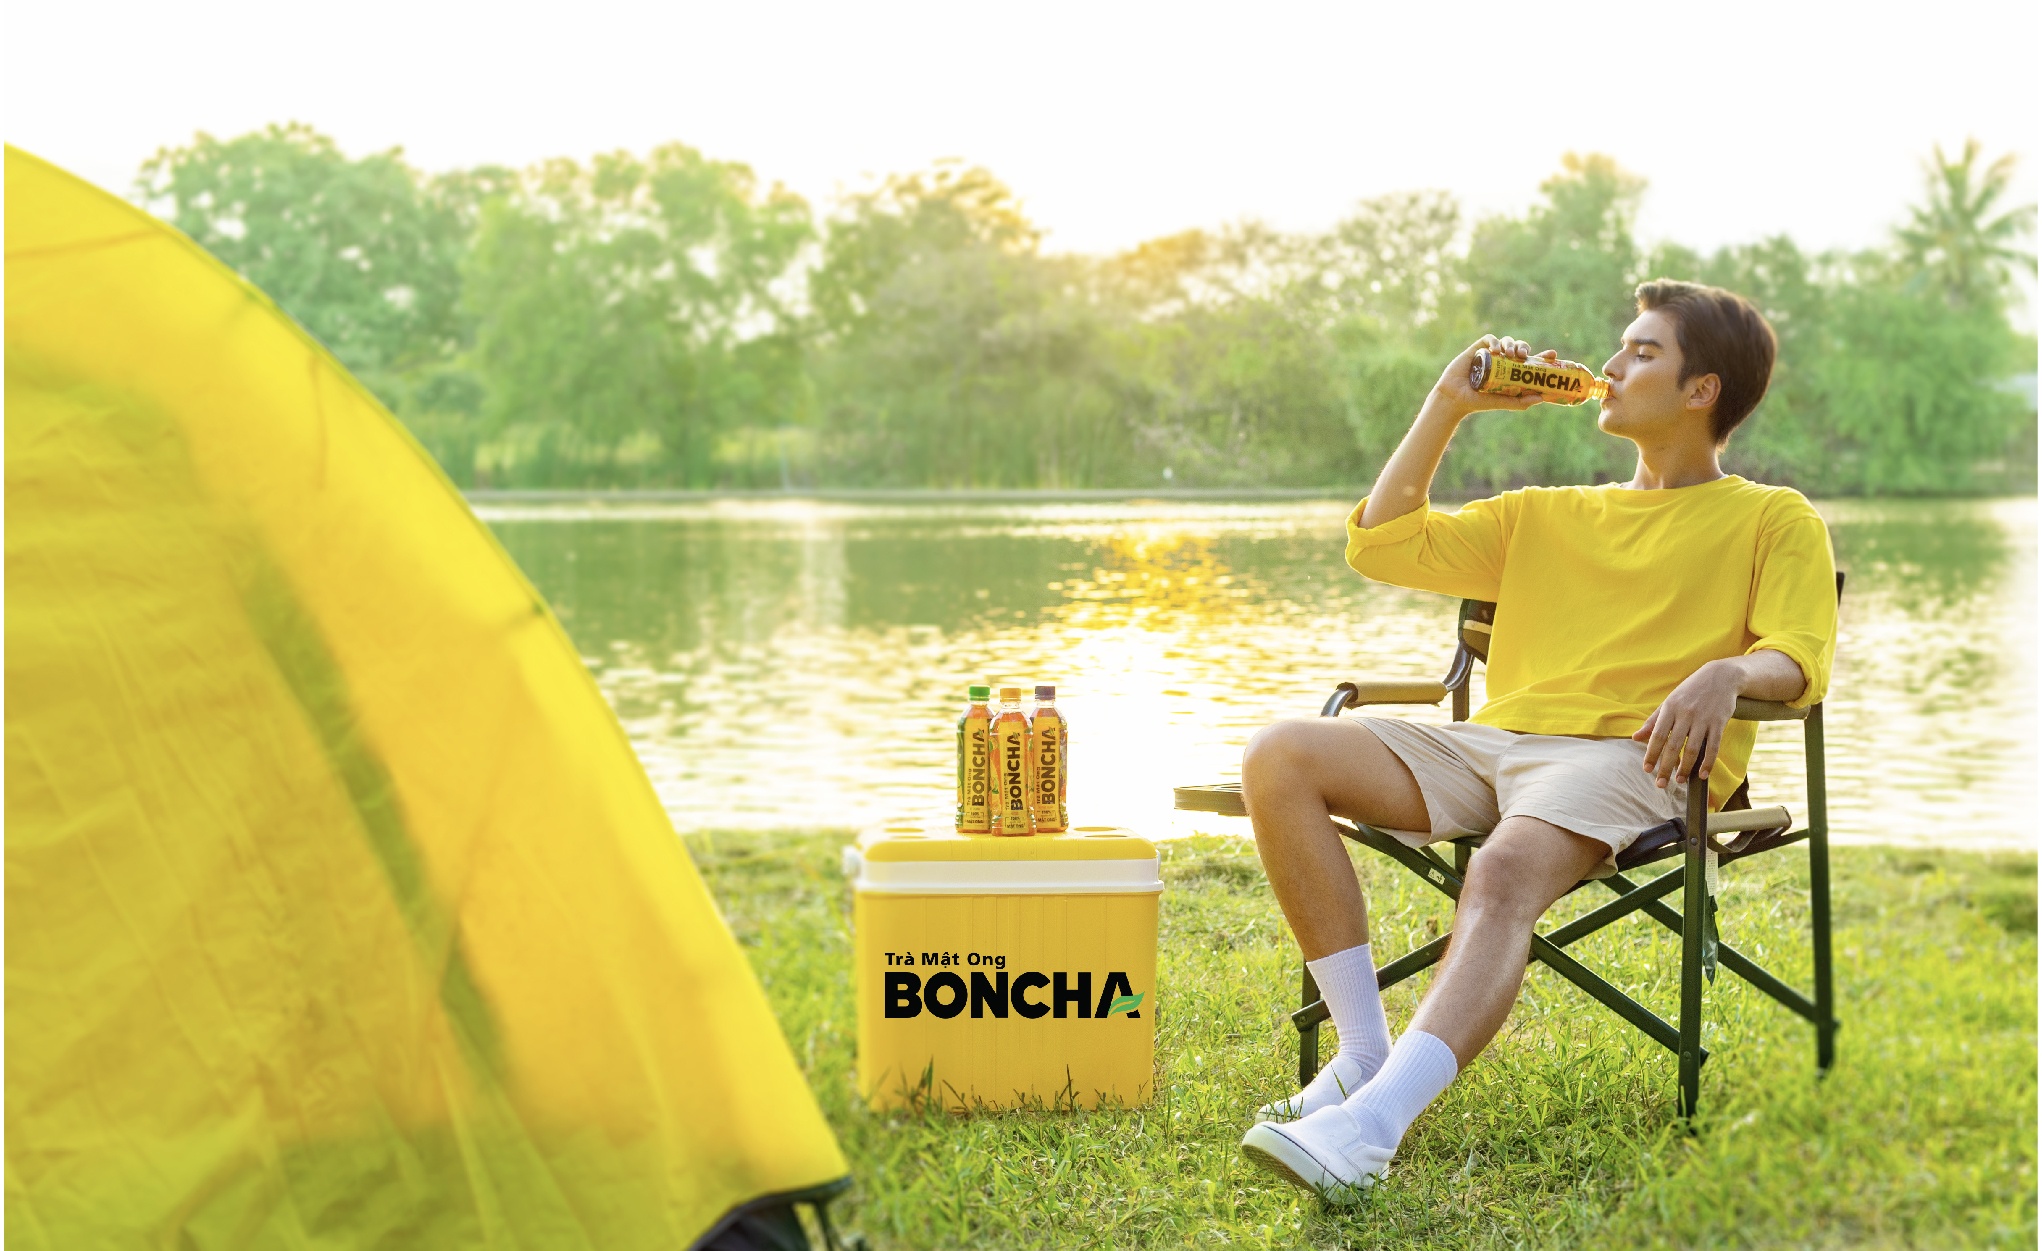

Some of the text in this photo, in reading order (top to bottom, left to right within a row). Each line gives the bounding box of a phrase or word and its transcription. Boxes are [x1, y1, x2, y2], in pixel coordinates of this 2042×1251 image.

[1510, 368, 1582, 393] BONCHA
[972, 729, 985, 807] BONCHA
[1007, 732, 1024, 811] BONCHA
[1041, 727, 1056, 805] BONCHA
[885, 951, 1006, 970] Trà Mật Ong
[884, 971, 1142, 1019] BONCHA
